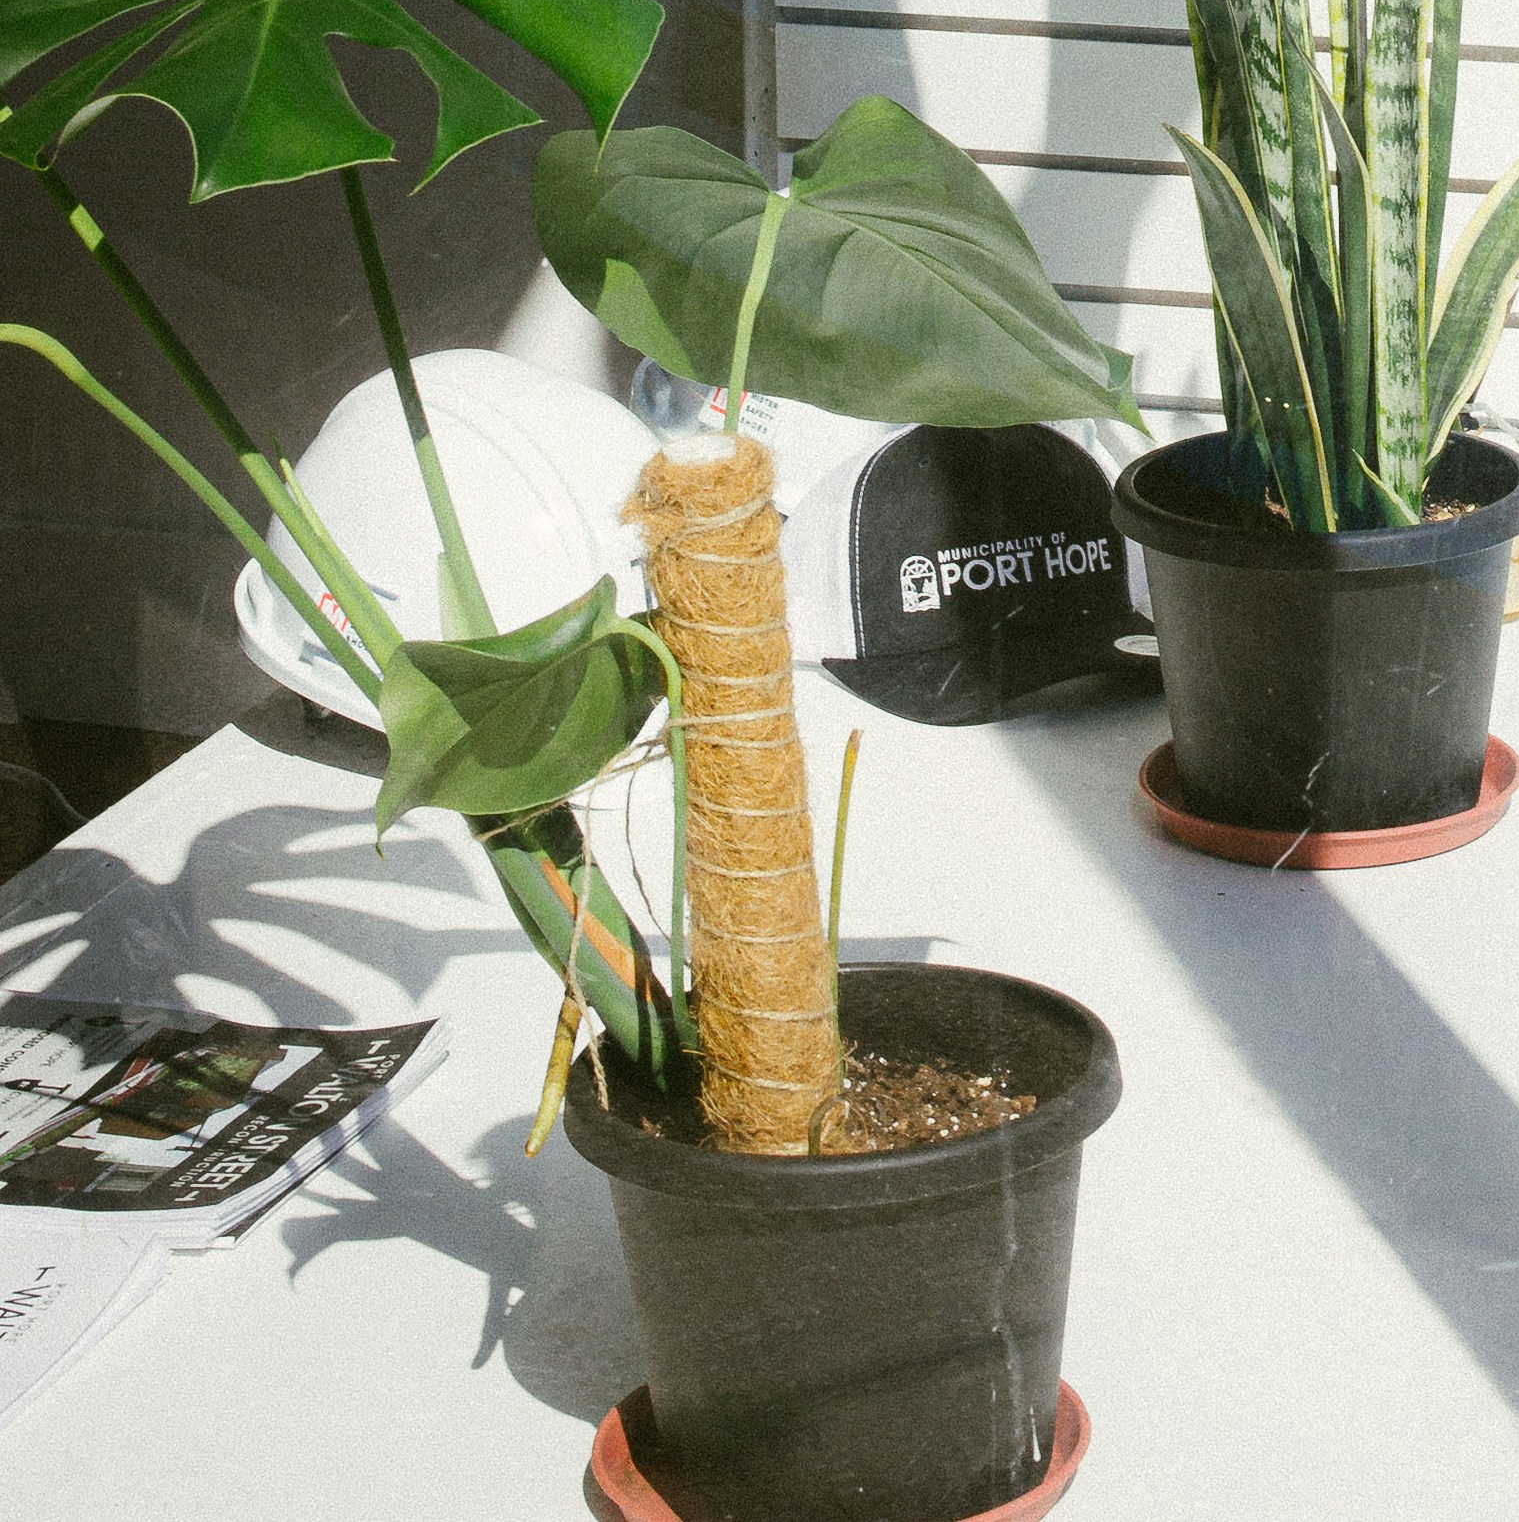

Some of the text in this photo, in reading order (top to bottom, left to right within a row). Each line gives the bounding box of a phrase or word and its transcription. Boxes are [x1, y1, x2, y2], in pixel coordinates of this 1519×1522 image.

[937, 531, 1067, 563] MUNICIPALITY OF
[939, 538, 1112, 596] PORT HOPE
[190, 1135, 289, 1191] STREET
